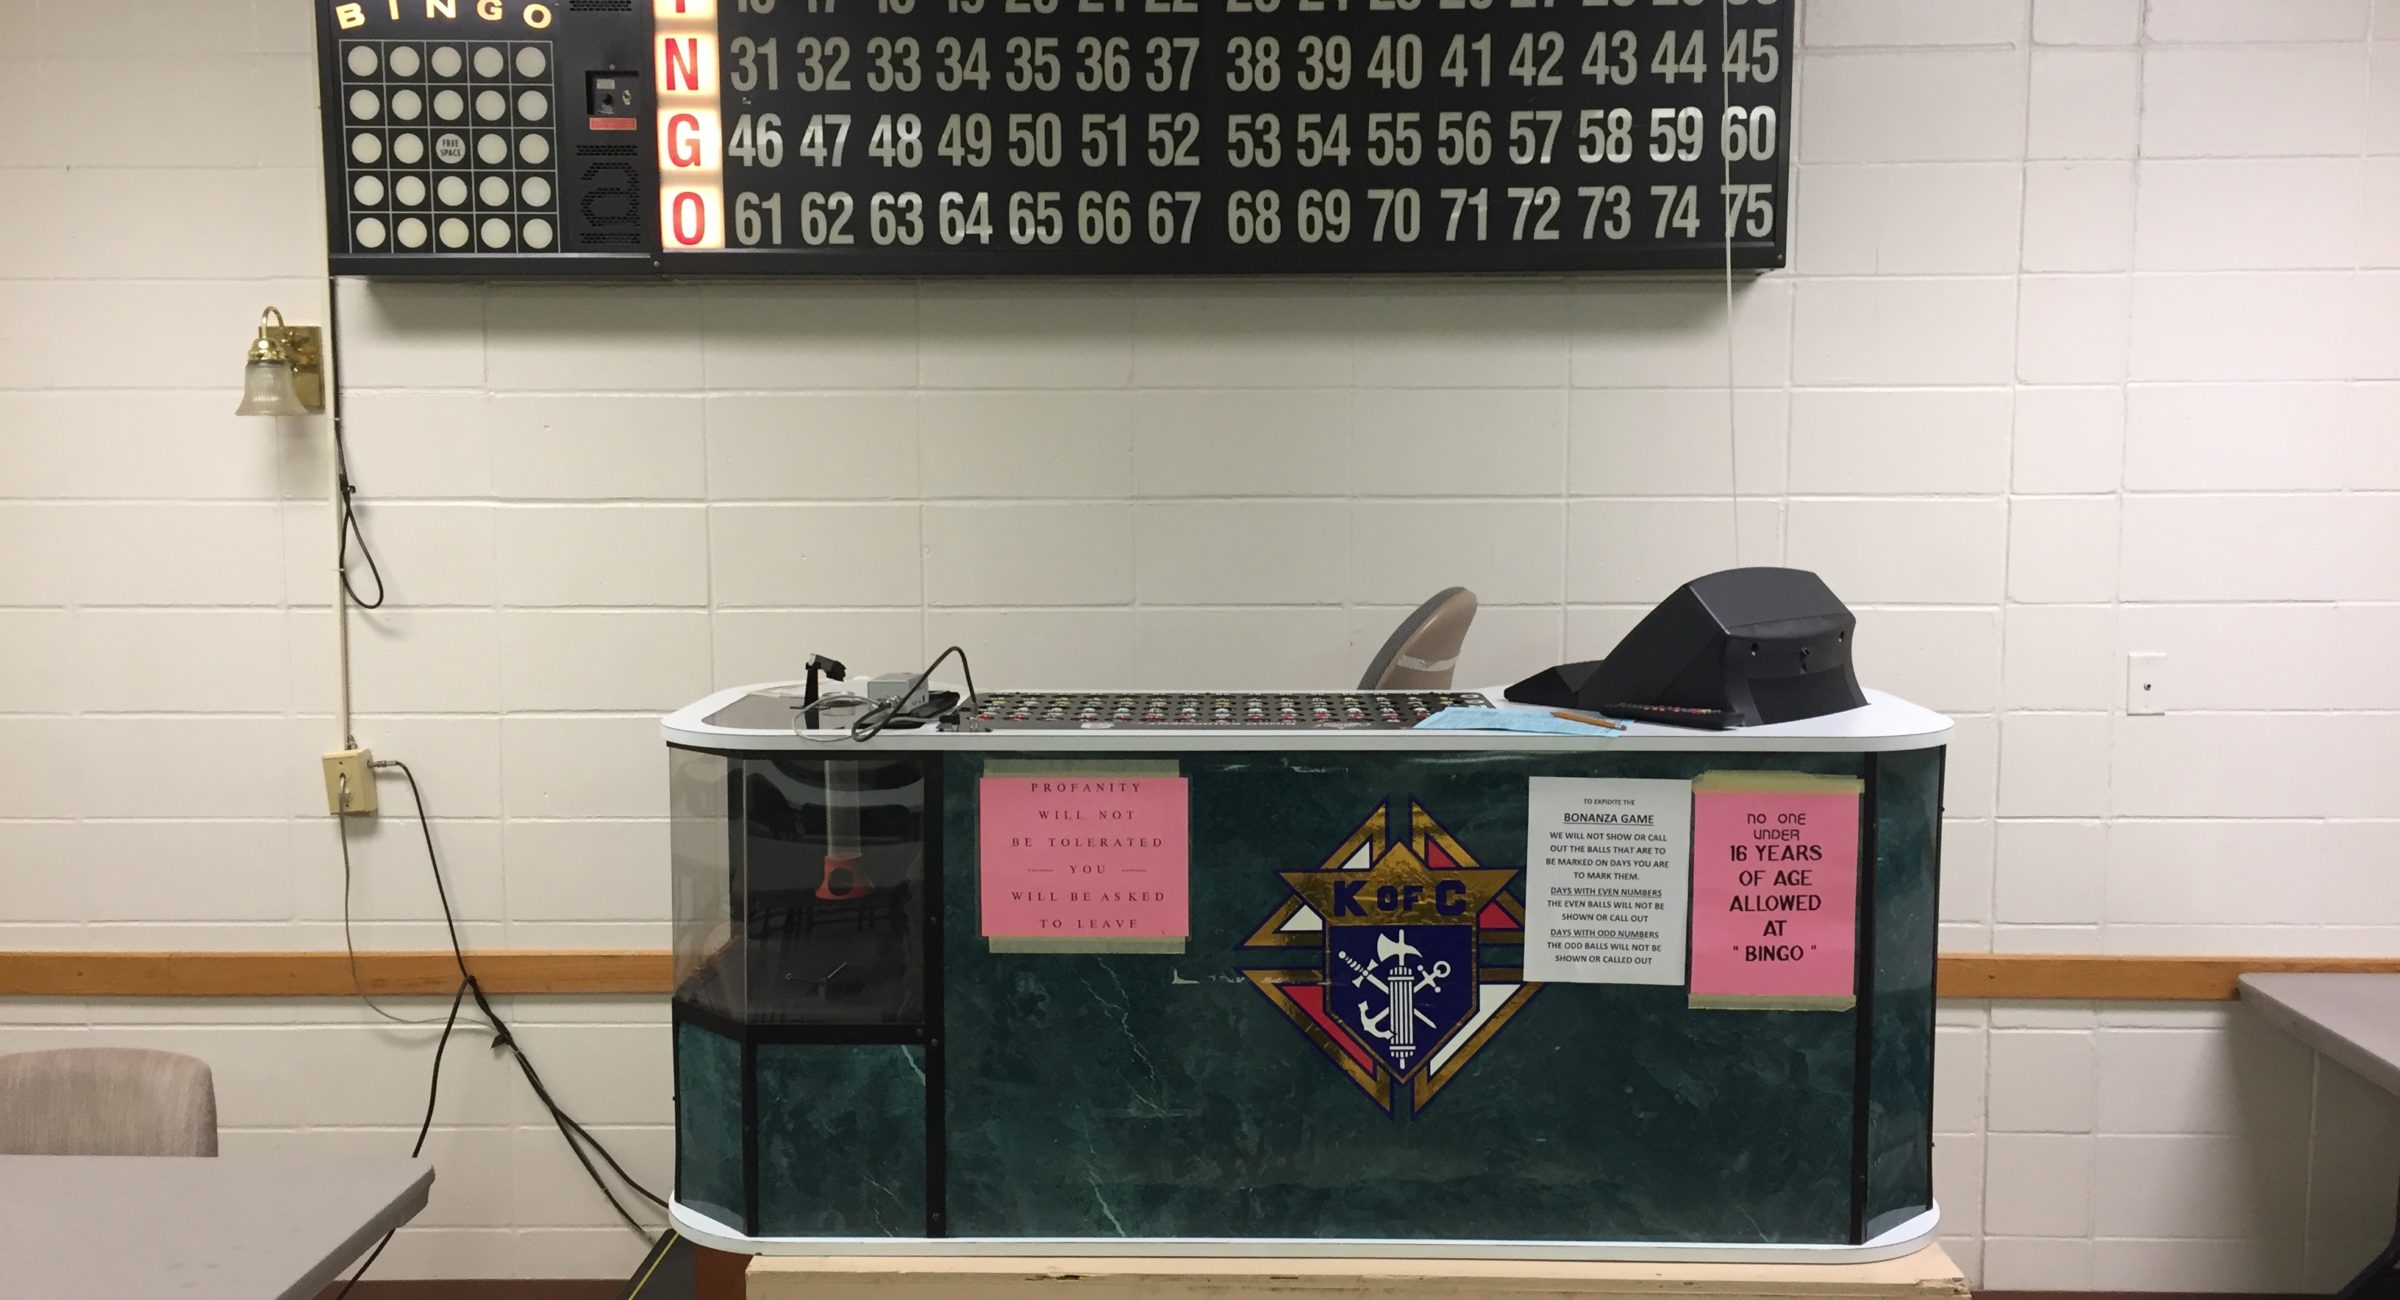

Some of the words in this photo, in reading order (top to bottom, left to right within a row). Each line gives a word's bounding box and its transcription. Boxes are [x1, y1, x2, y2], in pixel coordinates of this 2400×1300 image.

[335, 0, 552, 30] BINGO
[665, 38, 698, 90] N
[730, 36, 778, 92] 31
[797, 37, 851, 91] 32
[867, 37, 921, 92] 33
[937, 37, 990, 91] 34
[1006, 37, 1060, 91] 35
[1077, 37, 1130, 91] 36
[1146, 37, 1199, 91] 37
[1227, 37, 1280, 91] 38
[1298, 36, 1351, 90] 39
[1368, 34, 1422, 89] 40
[1441, 34, 1490, 87] 41
[1509, 31, 1564, 86] 42
[1582, 30, 1637, 85] 43
[1651, 30, 1707, 84] 44
[1723, 28, 1779, 83] 45
[668, 113, 701, 167] G
[728, 113, 783, 168] 46
[800, 114, 851, 167] 47
[868, 113, 923, 168] 48
[938, 113, 991, 167] 49
[1009, 113, 1061, 167] 50
[1082, 114, 1126, 166] 51
[1148, 113, 1199, 166] 52
[1228, 113, 1281, 167] 53
[1297, 114, 1350, 167] 54
[1368, 113, 1421, 166] 55
[1438, 111, 1491, 165] 56
[1509, 111, 1562, 164] 57
[1579, 108, 1632, 163] 58
[1649, 106, 1703, 162] 59
[1721, 105, 1776, 160] 60
[442, 139, 458, 148] FREE
[440, 149, 462, 157] SPACE
[673, 192, 705, 245] O
[735, 191, 782, 245] 61
[801, 191, 854, 245] 62
[870, 191, 923, 245] 63
[939, 191, 993, 245] 64
[1009, 191, 1063, 244] 65
[1078, 191, 1131, 244] 66
[1149, 191, 1201, 244] 67
[1228, 190, 1281, 244] 68
[1298, 189, 1350, 242] 69
[1368, 188, 1420, 242] 70
[1441, 188, 1488, 241] 71
[1508, 186, 1560, 240] 72
[1578, 185, 1631, 239] 73
[1651, 185, 1700, 238] 74
[1720, 183, 1773, 238] 75
[1031, 783, 1141, 792] PROFANITY
[1039, 811, 1083, 819] WILL
[1099, 811, 1135, 819] NOT
[1564, 813, 1617, 823] BONANZA
[1621, 814, 1654, 824] GAME
[1565, 832, 1584, 840] WILL
[1012, 838, 1033, 847] BE
[1048, 838, 1162, 847] TOLERATED
[1613, 846, 1634, 854] THAT
[1731, 845, 1747, 861] 16
[1755, 845, 1822, 861] YEARS
[1070, 865, 1106, 874] YOU
[1739, 871, 1765, 886] OF
[1773, 870, 1812, 886] AGE
[1012, 892, 1057, 901] WILL
[1071, 892, 1091, 901] BE
[1102, 892, 1164, 901] ASKED
[1621, 889, 1662, 897] NUMBERS
[1333, 880, 1368, 917] K
[1377, 885, 1424, 911] OF
[1436, 880, 1466, 916] C
[1729, 895, 1821, 912] ALLOWED
[1040, 919, 1062, 928] TO
[1078, 919, 1137, 928] LEAVE
[1763, 920, 1787, 936] AT
[1611, 943, 1630, 951] WILL
